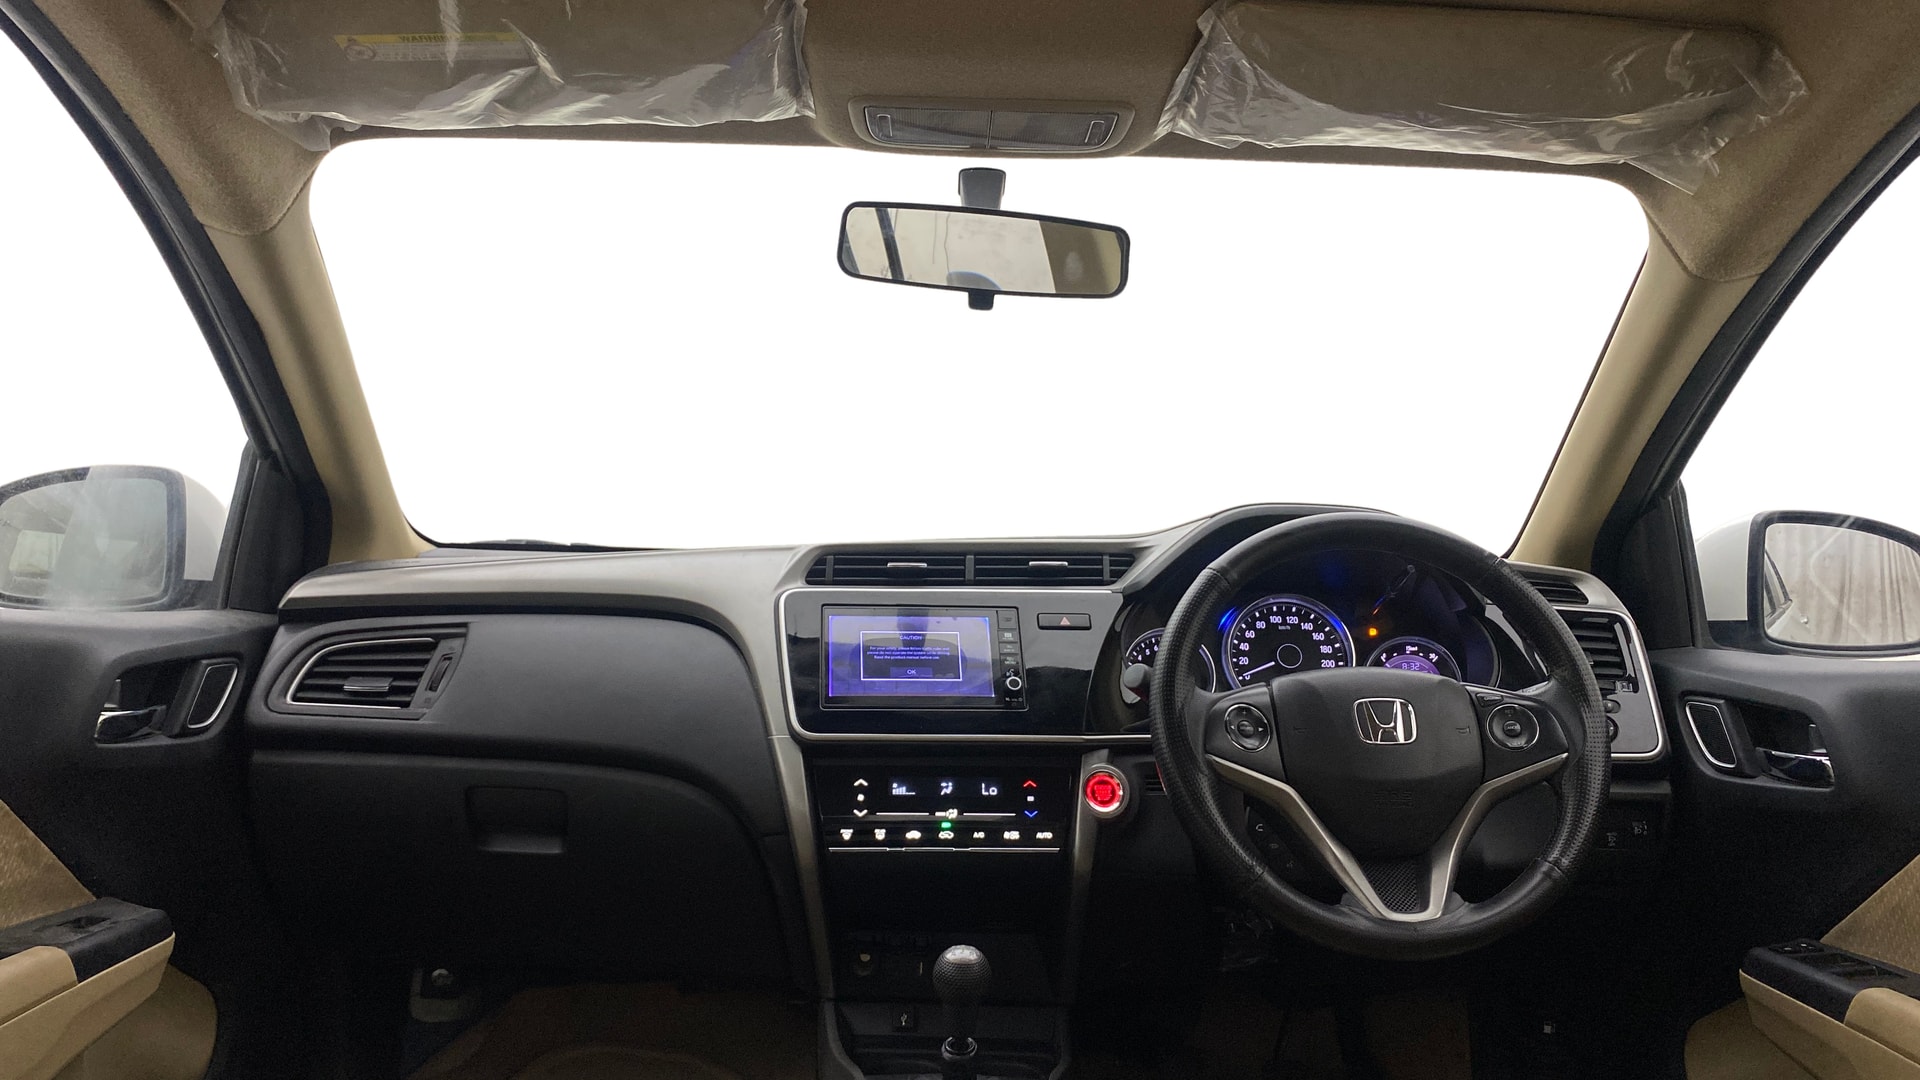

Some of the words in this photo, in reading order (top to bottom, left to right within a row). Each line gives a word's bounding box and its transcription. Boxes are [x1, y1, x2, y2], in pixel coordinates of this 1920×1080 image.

[1269, 615, 1282, 624] 100
[1286, 616, 1299, 624] 120
[1255, 620, 1266, 629] 80
[1300, 622, 1313, 631] 140
[1245, 630, 1255, 638] 60
[1312, 632, 1324, 641] 160
[1153, 644, 1159, 652] 6
[1239, 642, 1249, 651] 40
[1320, 645, 1332, 654] 180
[1145, 648, 1150, 656] 5
[1239, 656, 1249, 666] 20
[1321, 659, 1335, 668] 200
[1401, 662, 1420, 671] 8:32
[981, 782, 998, 796] Lo
